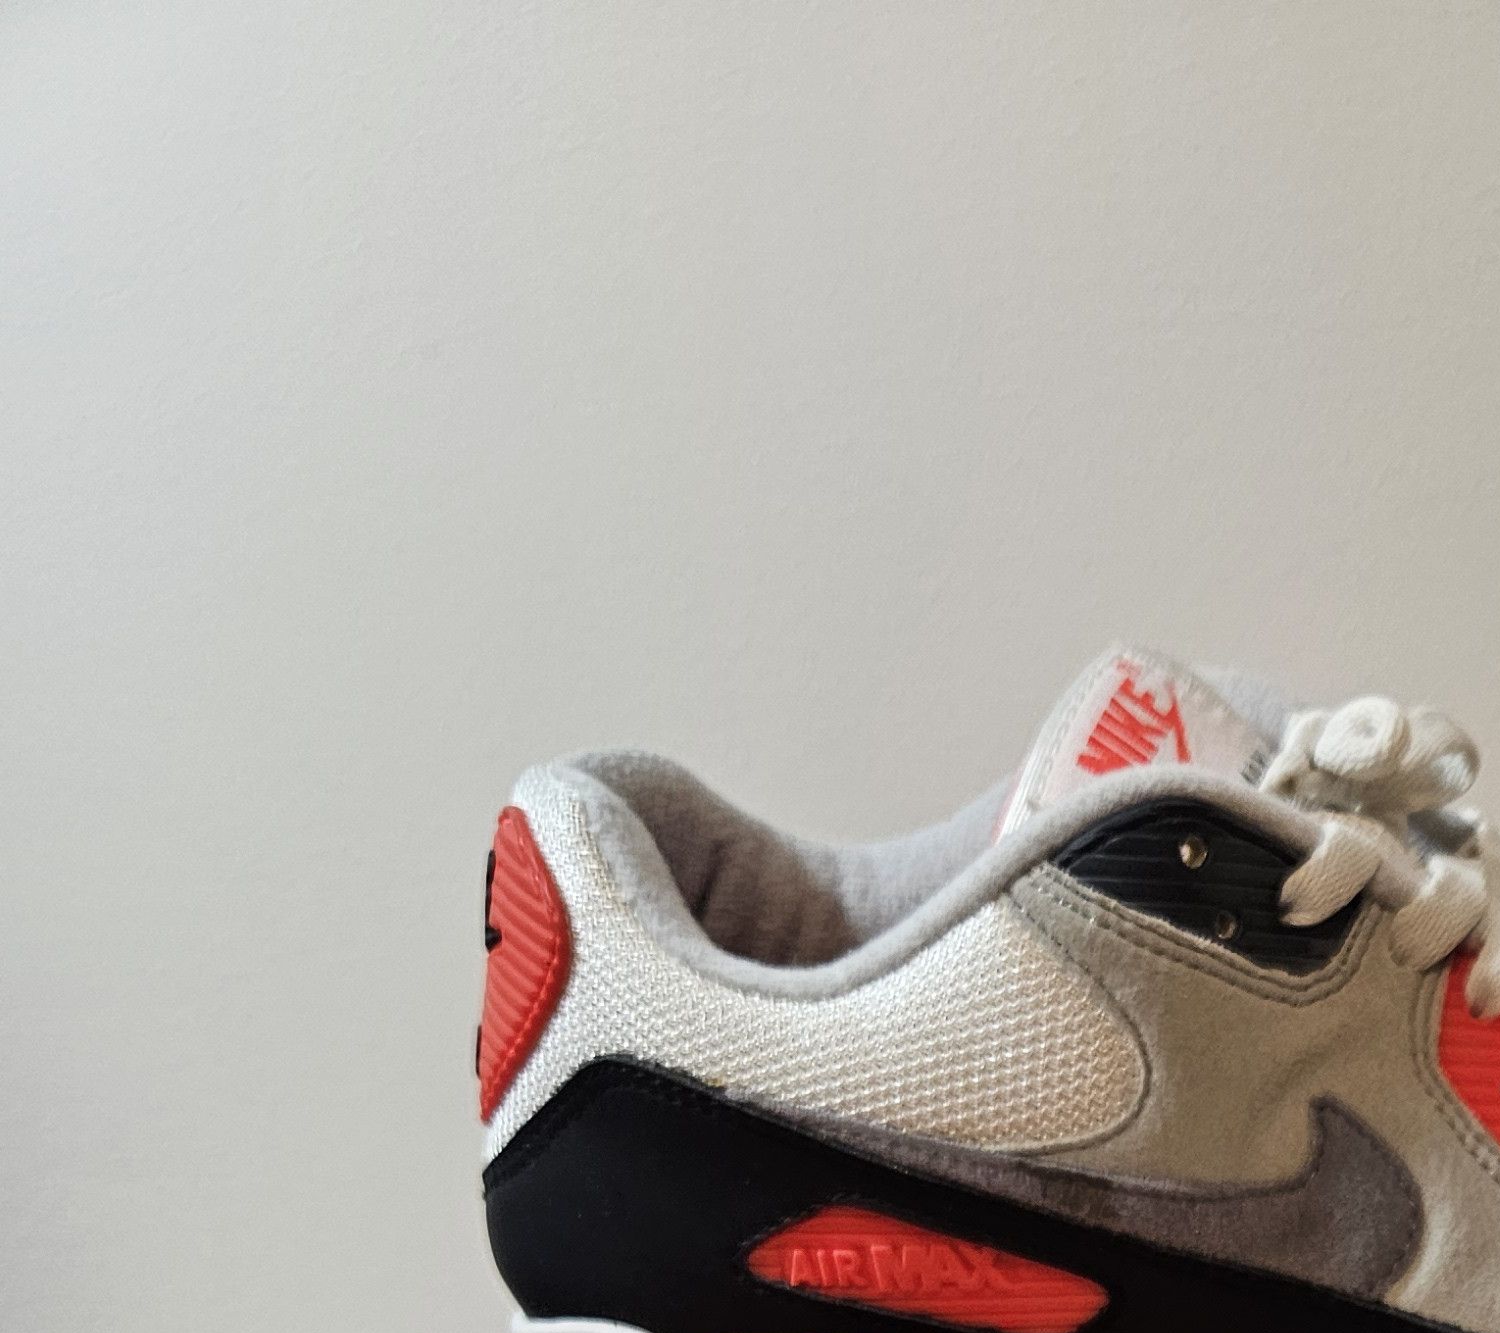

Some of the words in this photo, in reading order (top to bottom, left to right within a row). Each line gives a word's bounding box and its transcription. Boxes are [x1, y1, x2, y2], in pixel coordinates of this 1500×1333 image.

[1076, 676, 1172, 776] NIKE
[789, 1248, 868, 1287] AIR
[869, 1244, 1018, 1297] MAX
